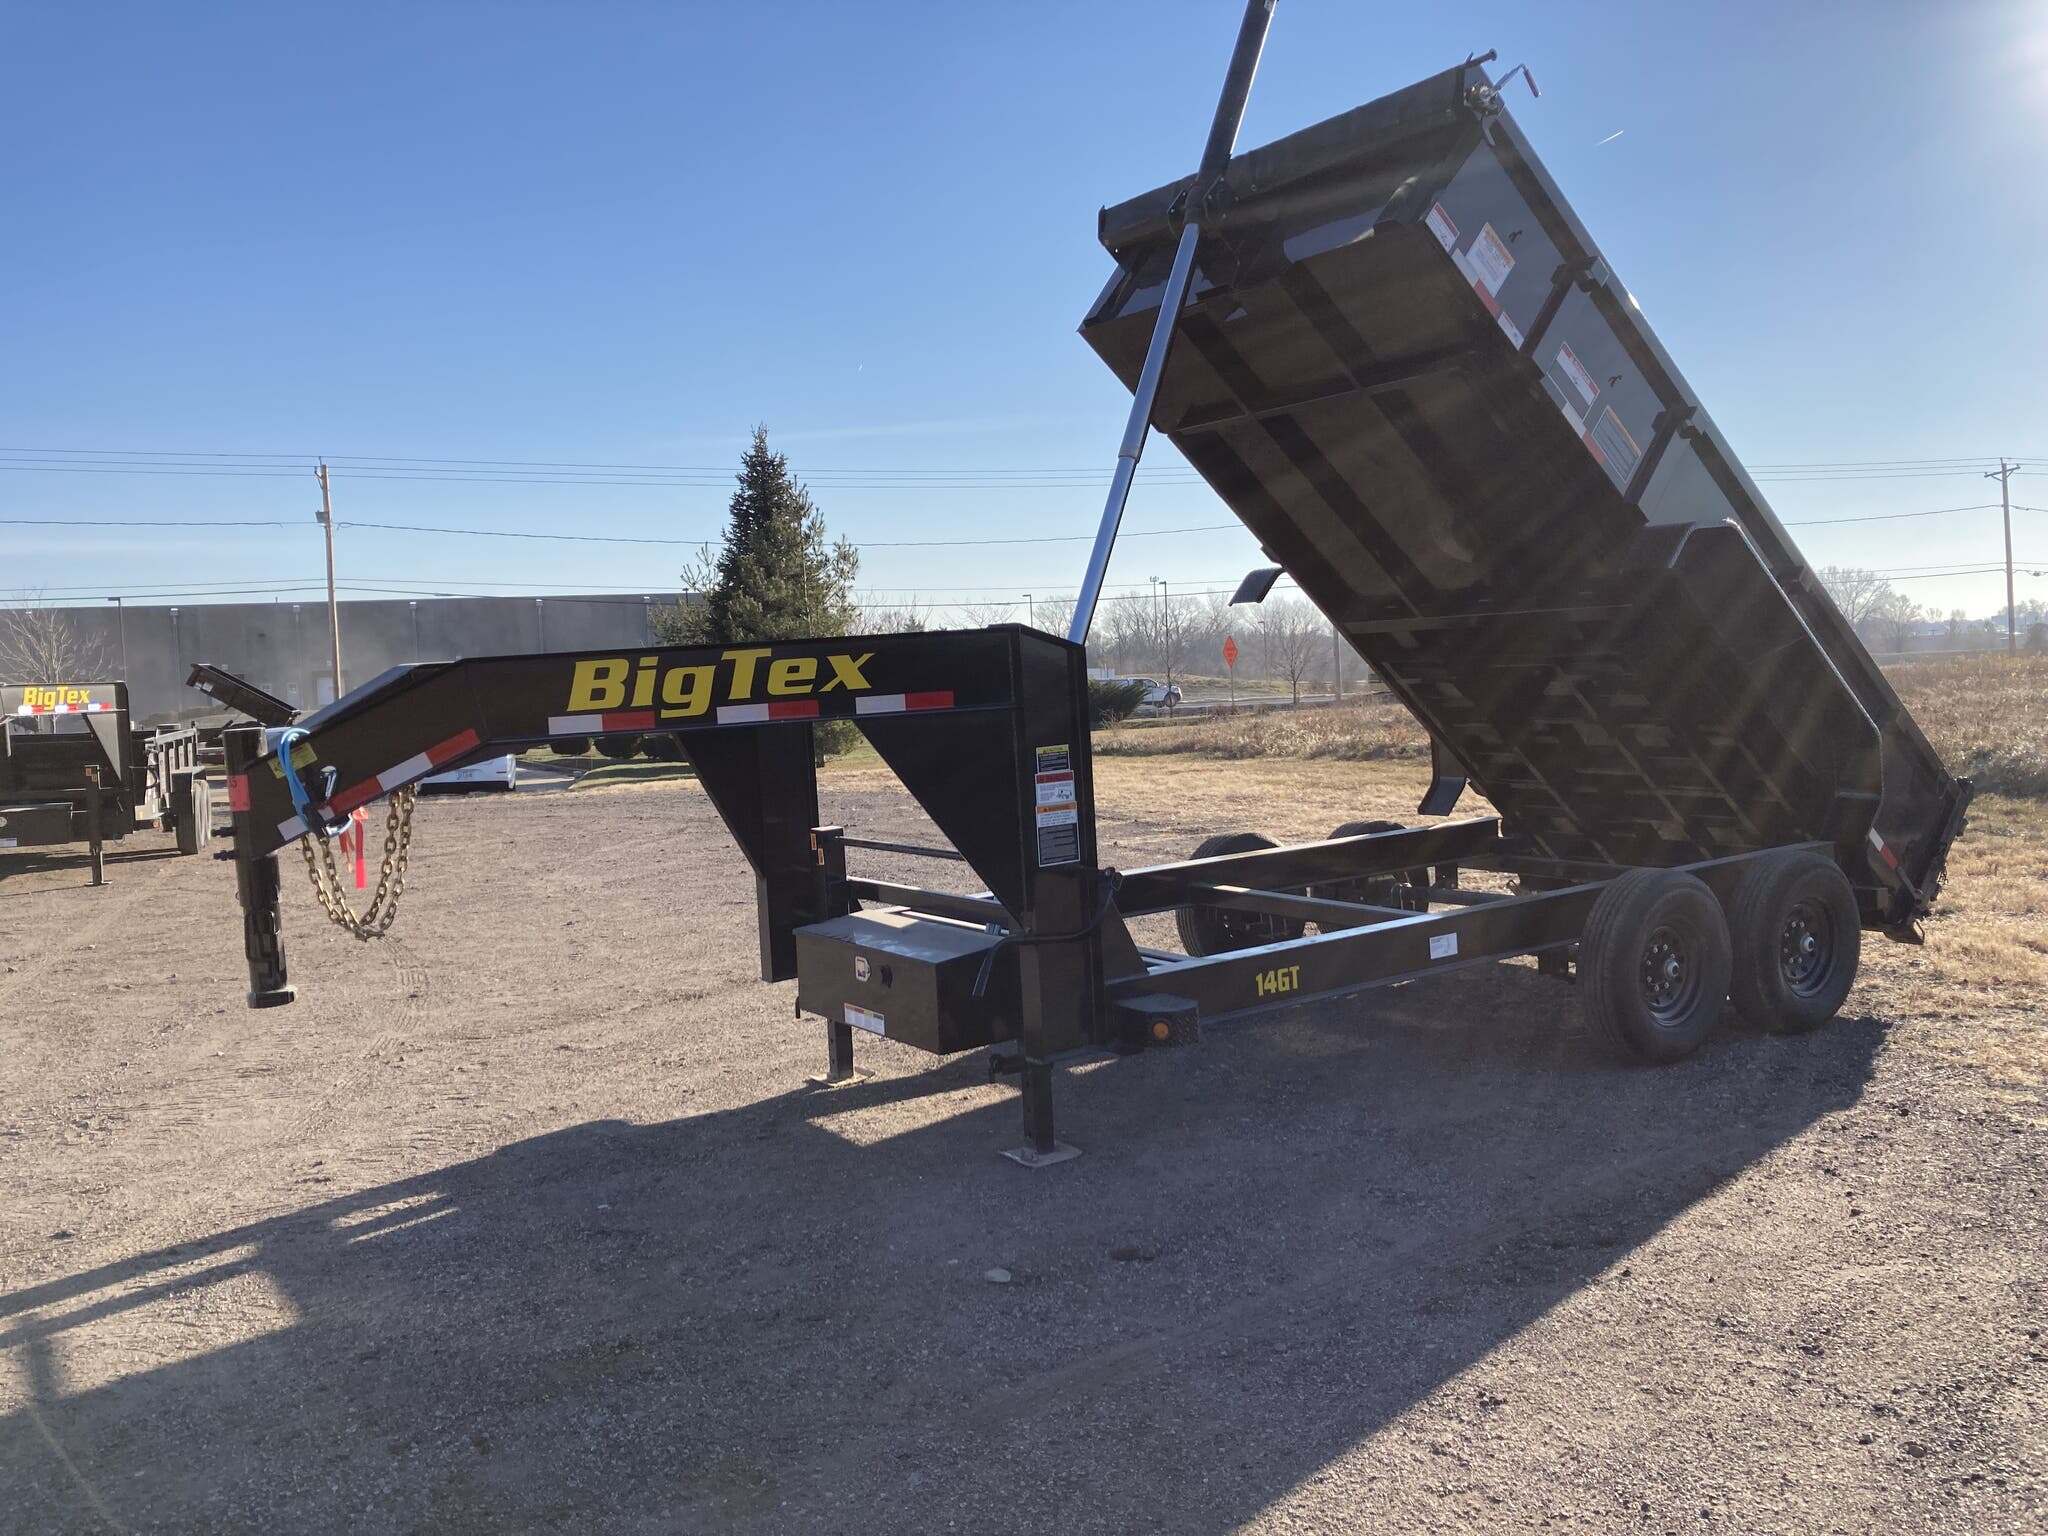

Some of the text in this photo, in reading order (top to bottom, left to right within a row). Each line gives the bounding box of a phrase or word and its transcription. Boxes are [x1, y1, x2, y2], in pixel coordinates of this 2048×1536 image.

[23, 687, 90, 710] BigTex
[566, 648, 876, 719] BigTex
[1256, 966, 1300, 997] 14GT
